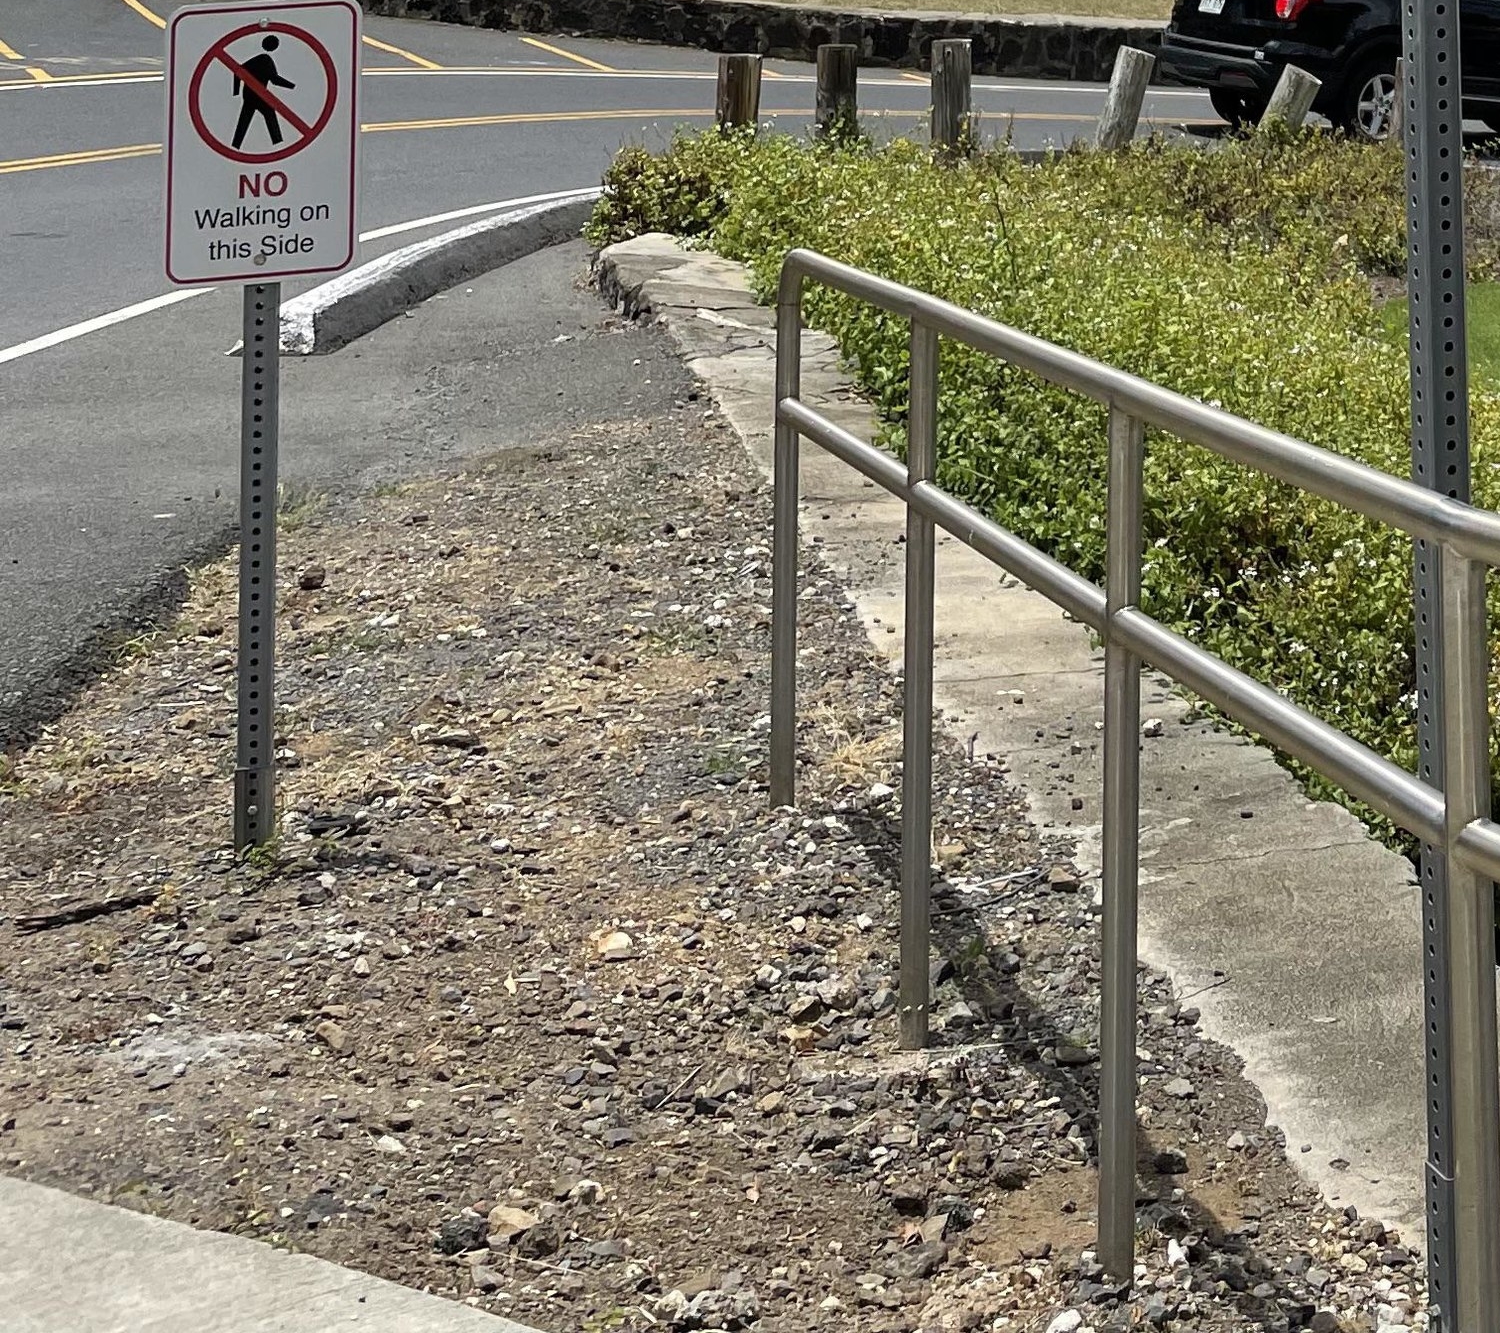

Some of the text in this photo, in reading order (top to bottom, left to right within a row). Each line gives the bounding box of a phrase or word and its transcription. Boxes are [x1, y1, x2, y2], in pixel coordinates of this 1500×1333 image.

[238, 171, 288, 199] NO
[195, 203, 330, 230] Walking on
[208, 233, 314, 261] this Side
